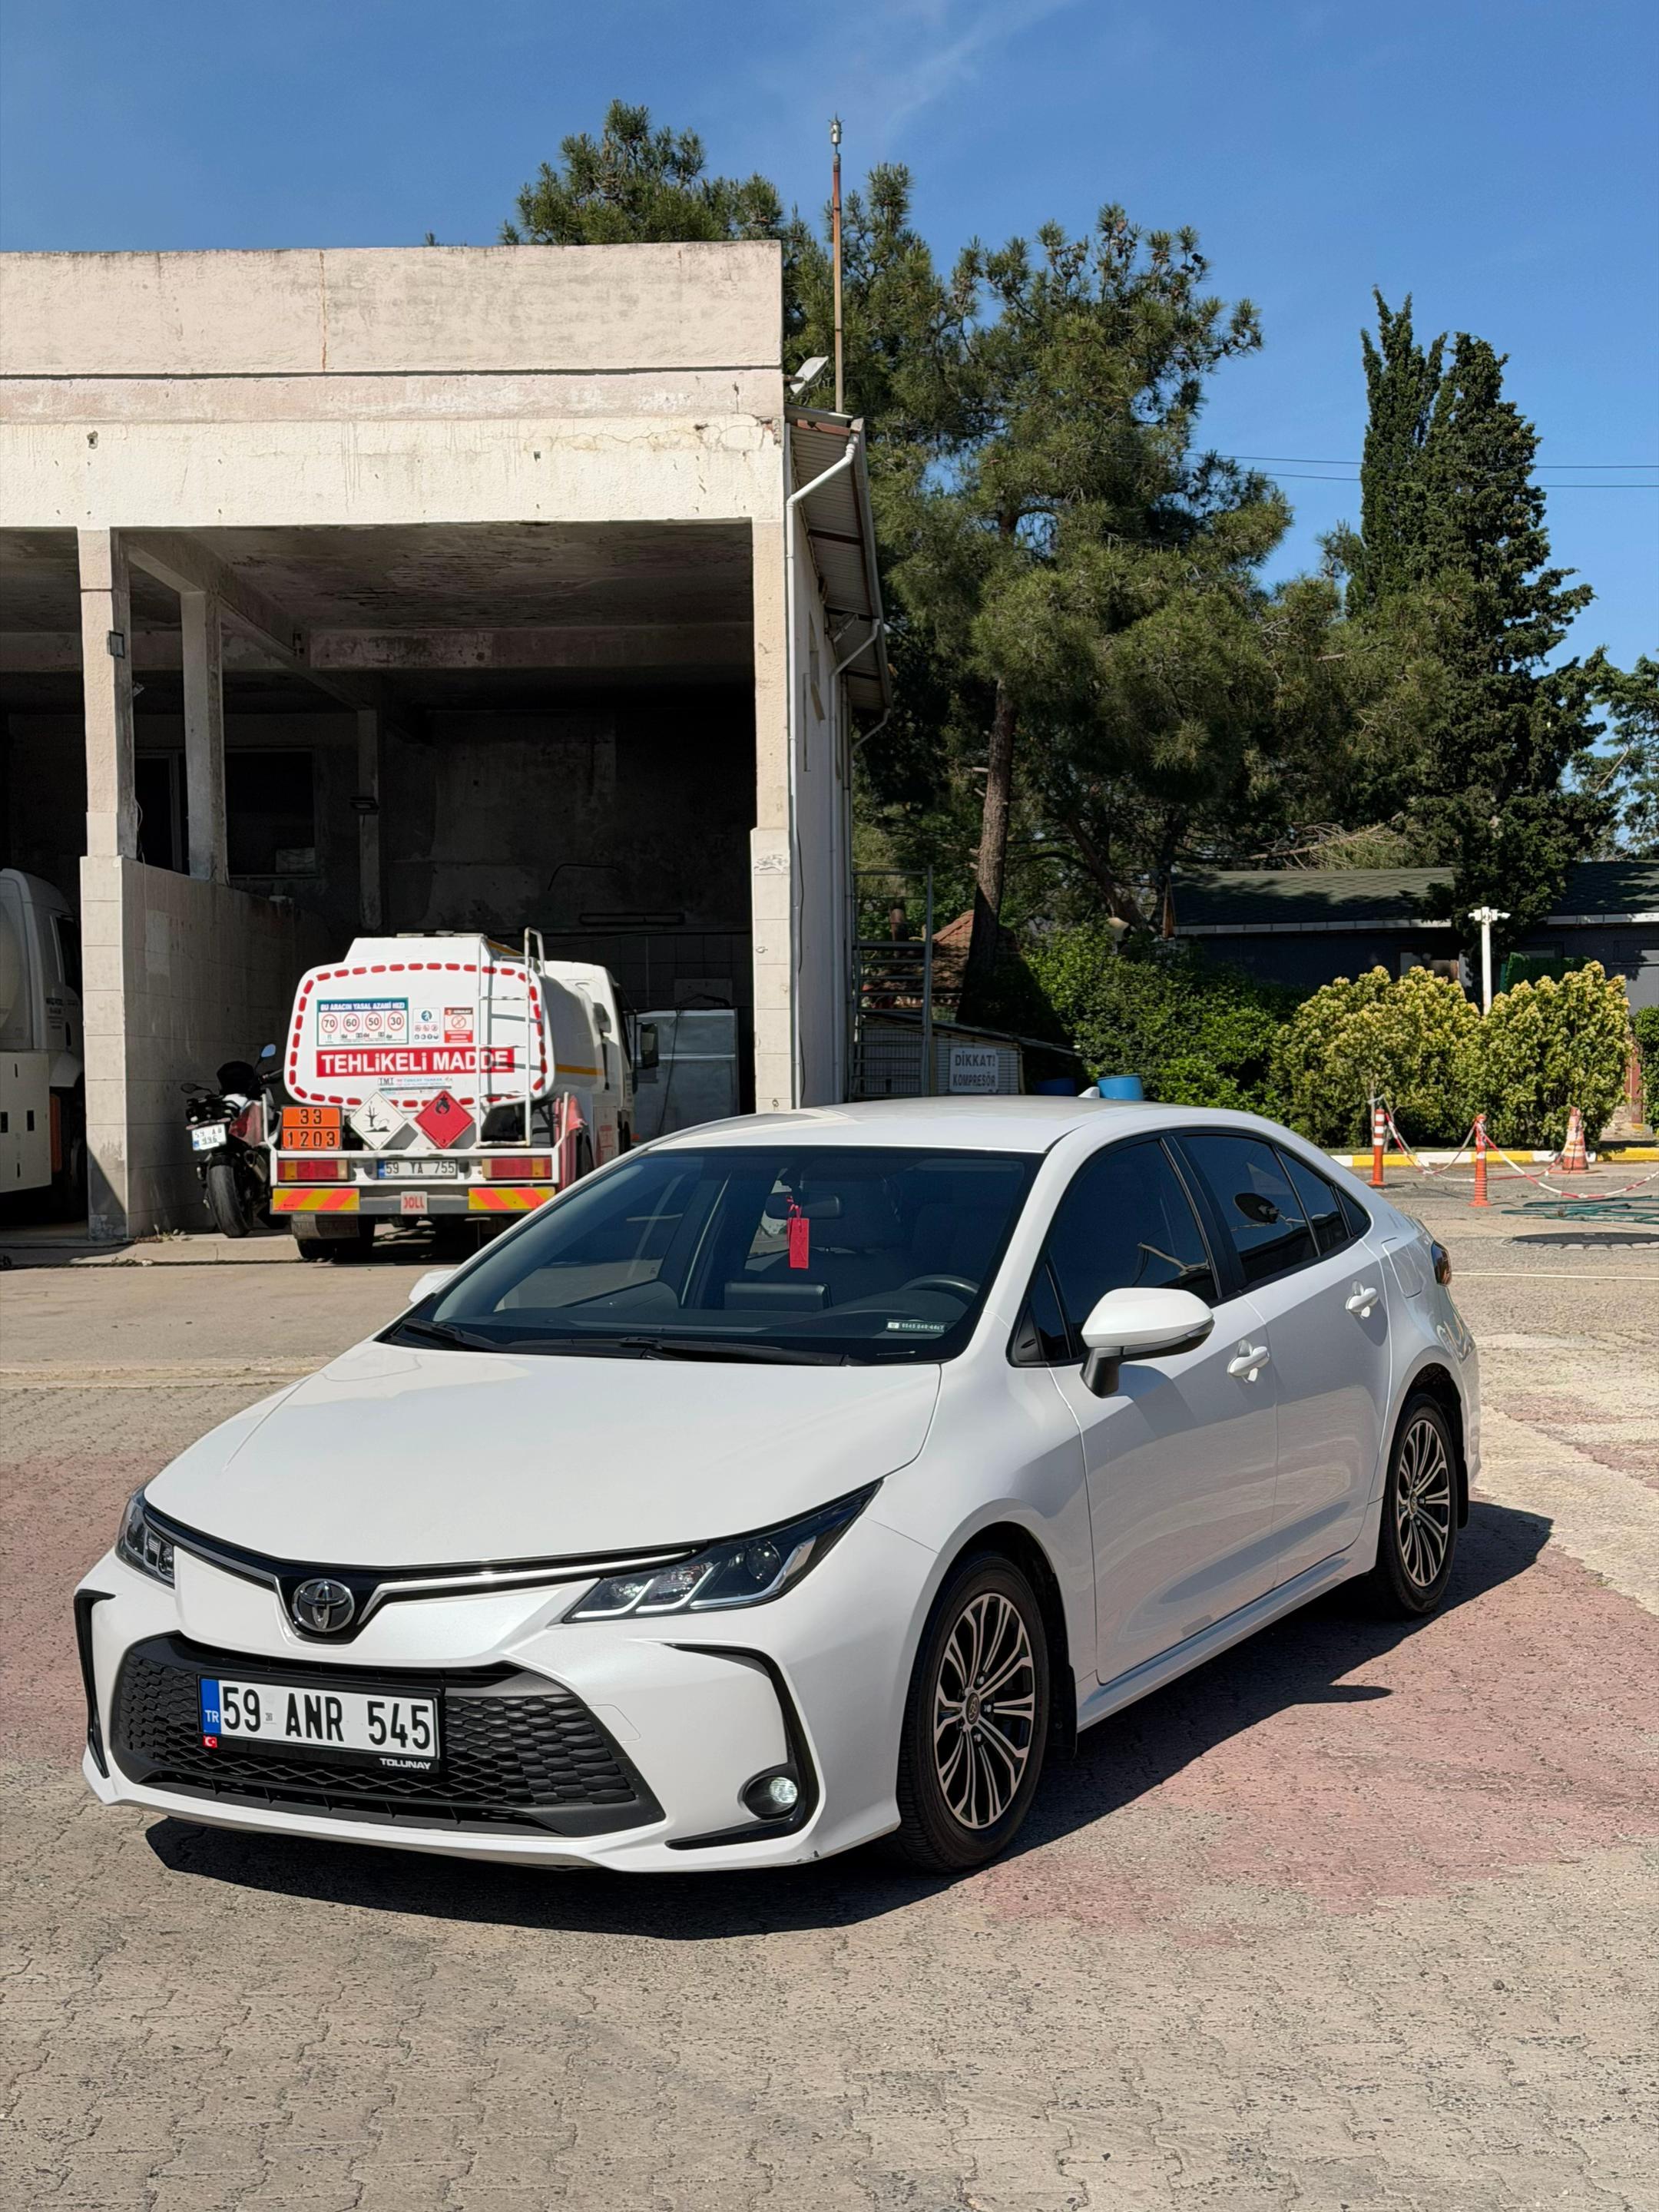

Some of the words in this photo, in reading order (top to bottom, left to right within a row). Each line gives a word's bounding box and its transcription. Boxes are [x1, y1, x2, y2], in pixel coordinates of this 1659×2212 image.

[323, 1019, 335, 1028] 70
[346, 1018, 357, 1027] 60
[369, 1018, 379, 1026] 50
[390, 1017, 402, 1025] 30
[433, 1051, 508, 1071] MADDE
[300, 1108, 322, 1124] 33
[289, 1131, 336, 1147] 1203
[386, 1161, 399, 1174] 59
[409, 1161, 424, 1174] YA
[434, 1161, 455, 1174] 755
[204, 1710, 220, 1724] TR
[222, 1686, 261, 1732] 59
[285, 1693, 344, 1742] ANR
[367, 1700, 430, 1750] 545
[379, 1757, 431, 1770] TOLUNAY
